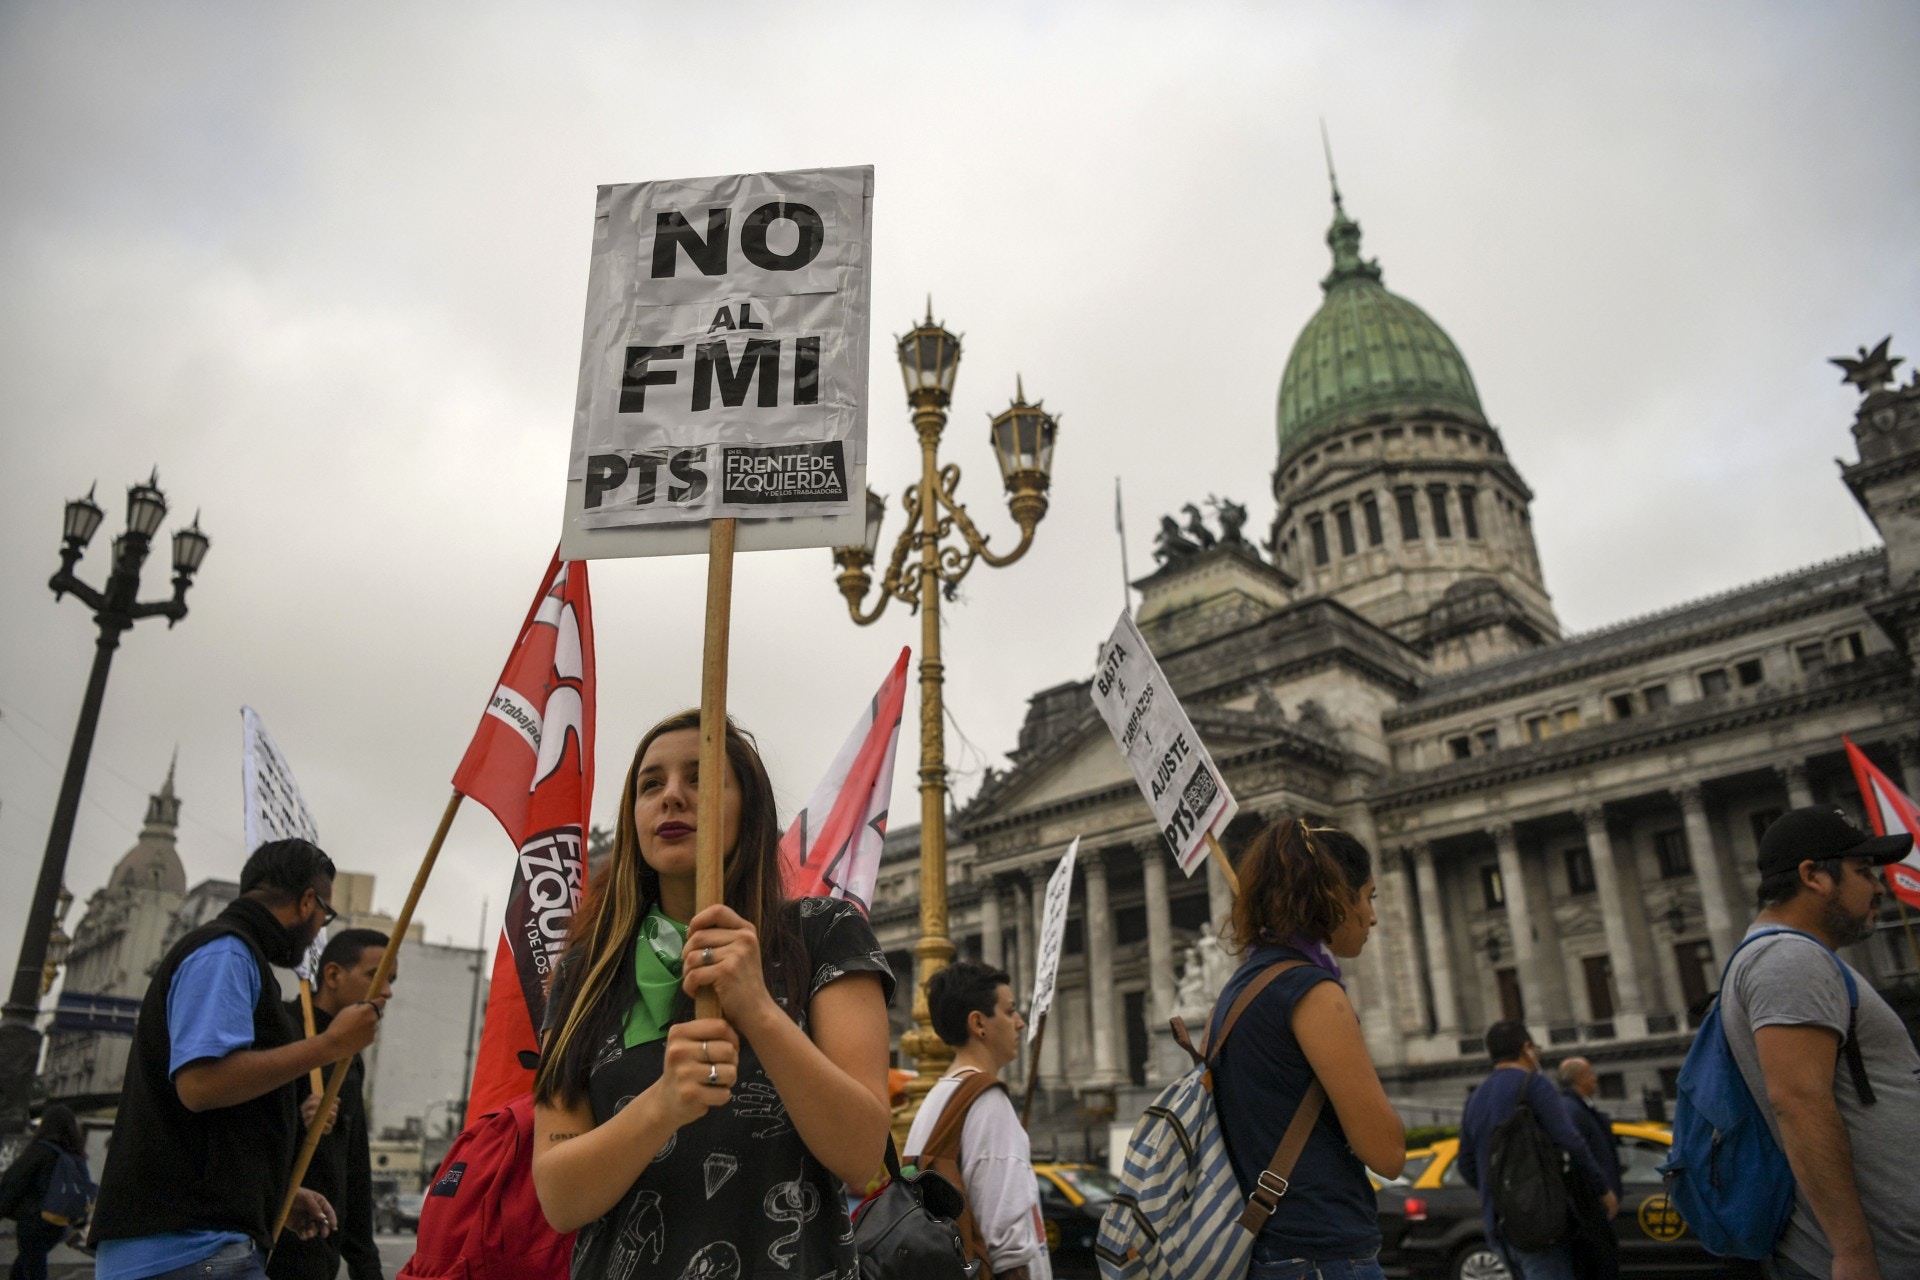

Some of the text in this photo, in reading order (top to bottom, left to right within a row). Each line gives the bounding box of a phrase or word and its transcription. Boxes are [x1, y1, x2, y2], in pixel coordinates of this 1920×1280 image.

[651, 201, 824, 278] NO
[707, 303, 763, 334] AL
[619, 336, 820, 413] FMI
[584, 447, 708, 510] PTS
[726, 470, 840, 493] IZQUIERDA
[1151, 732, 1190, 802] AJUSTE
[1164, 798, 1195, 857] PTS
[524, 918, 536, 928] Y
[527, 929, 542, 947] DE
[532, 947, 549, 975] LOS
